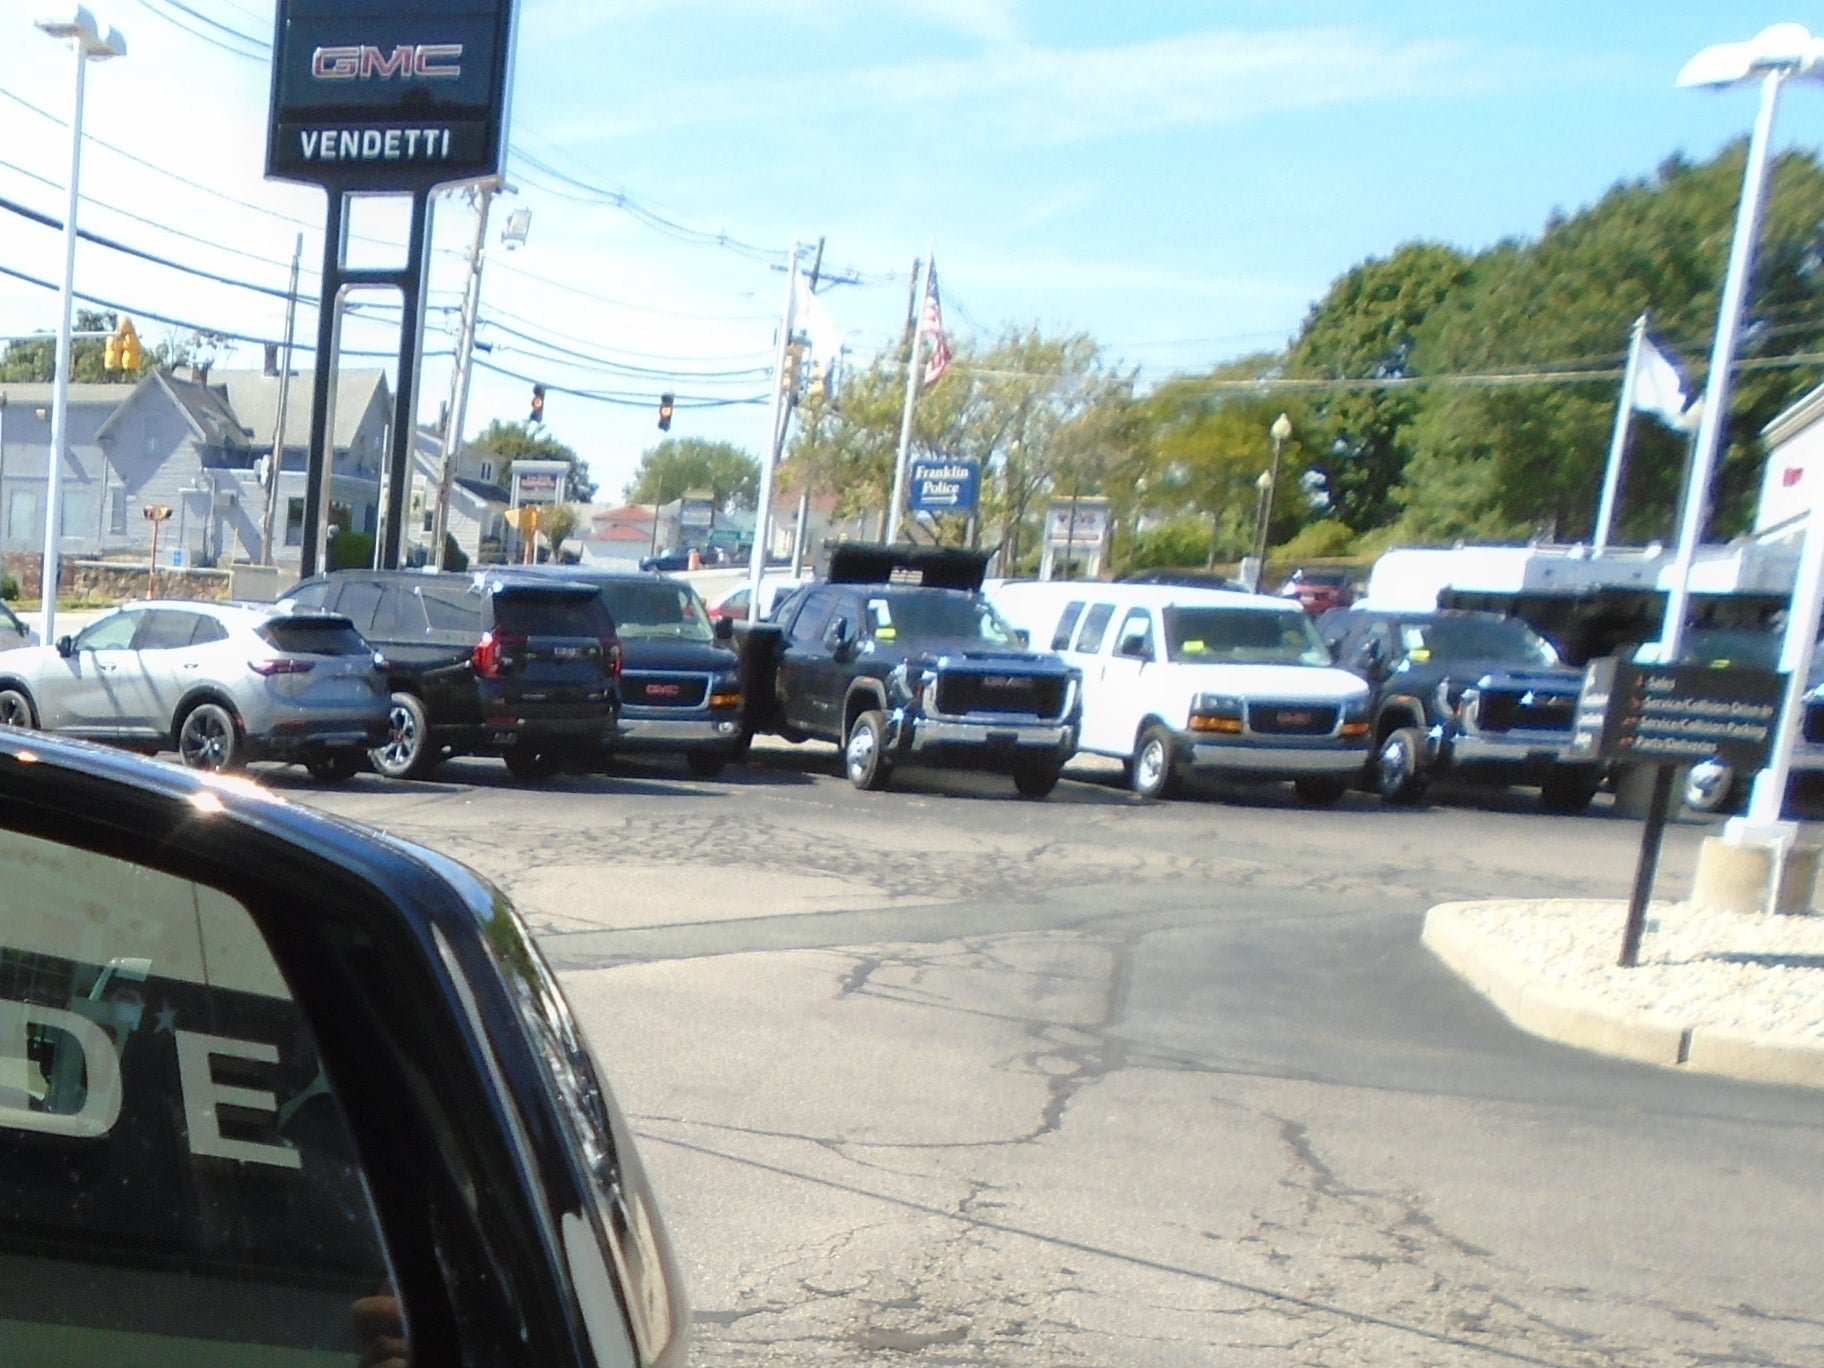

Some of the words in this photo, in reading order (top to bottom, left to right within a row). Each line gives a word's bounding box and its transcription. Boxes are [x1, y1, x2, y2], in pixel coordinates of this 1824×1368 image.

[312, 44, 463, 78] GMC
[301, 129, 450, 159] VENDETTI
[916, 465, 968, 480] Franklin
[922, 481, 960, 495] Police
[646, 685, 679, 695] GMC
